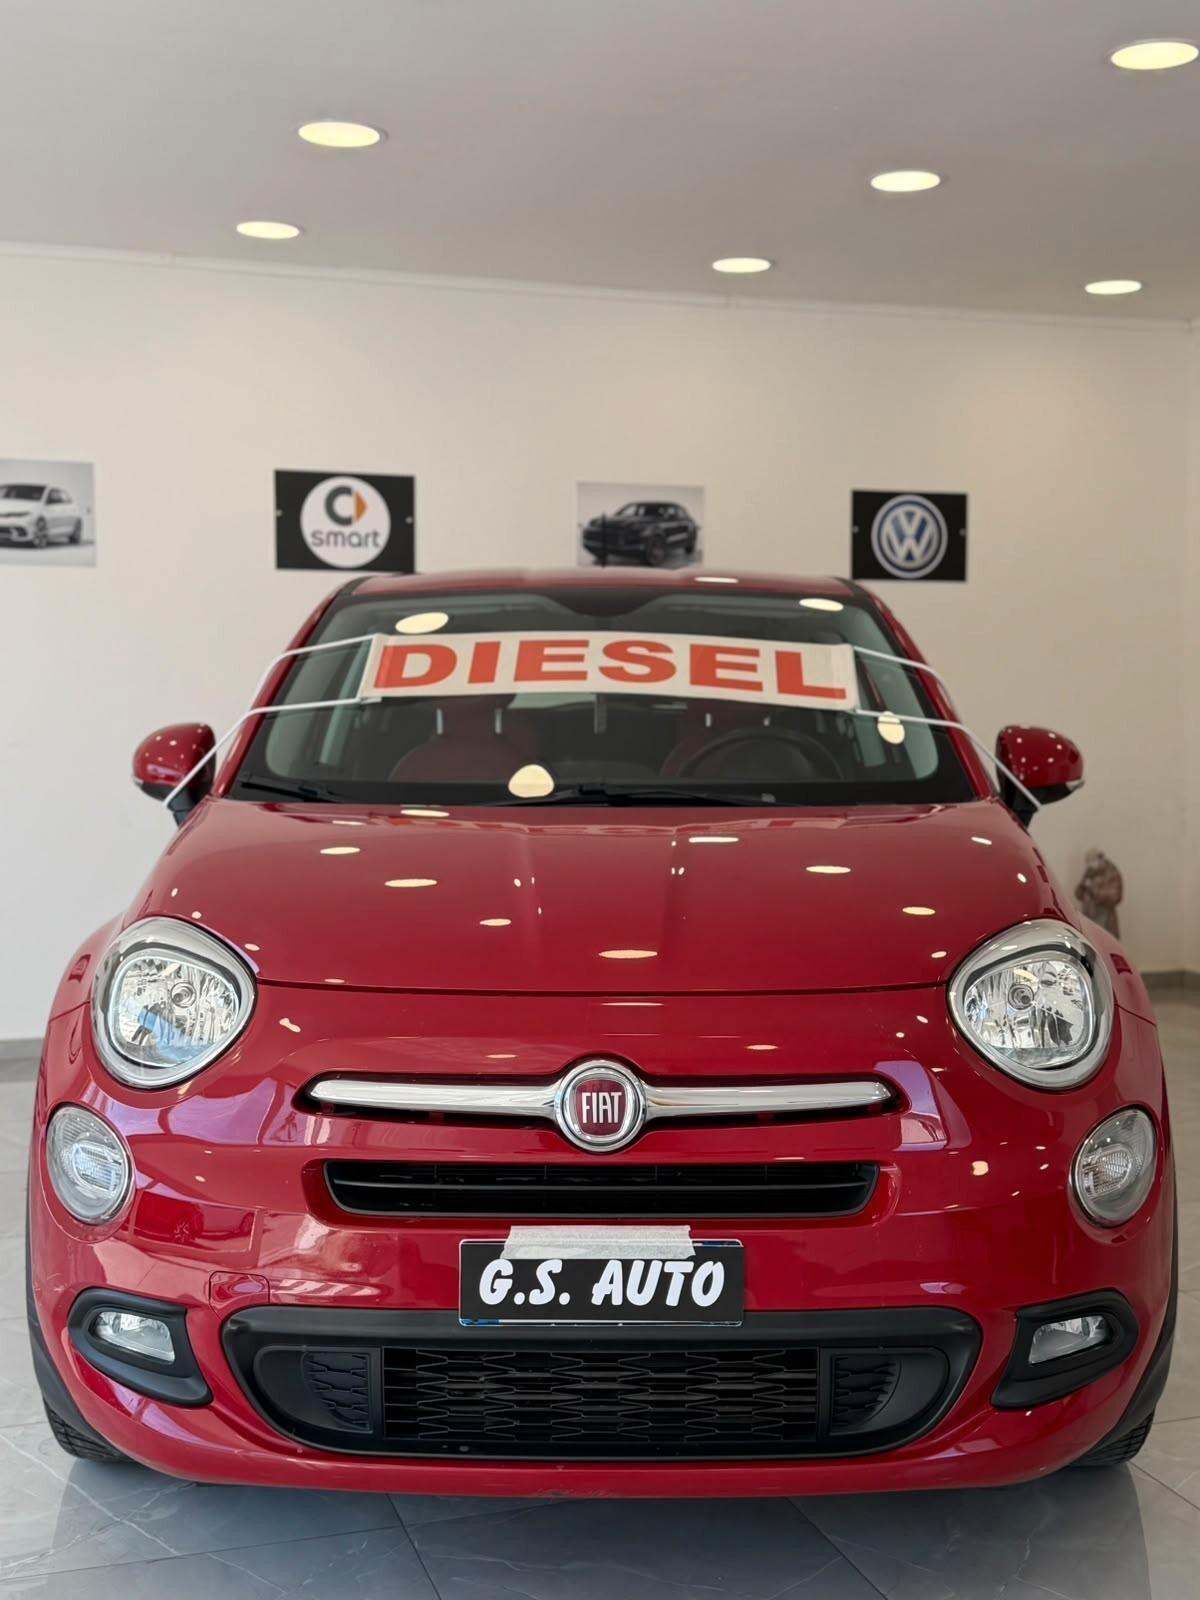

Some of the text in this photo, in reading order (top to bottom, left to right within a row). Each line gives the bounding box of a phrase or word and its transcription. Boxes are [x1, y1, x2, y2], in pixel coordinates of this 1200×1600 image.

[311, 529, 381, 548] smart
[373, 639, 847, 700] DIESEL
[581, 1092, 622, 1124] FIAT
[479, 1258, 725, 1307] G.S. AUTO
